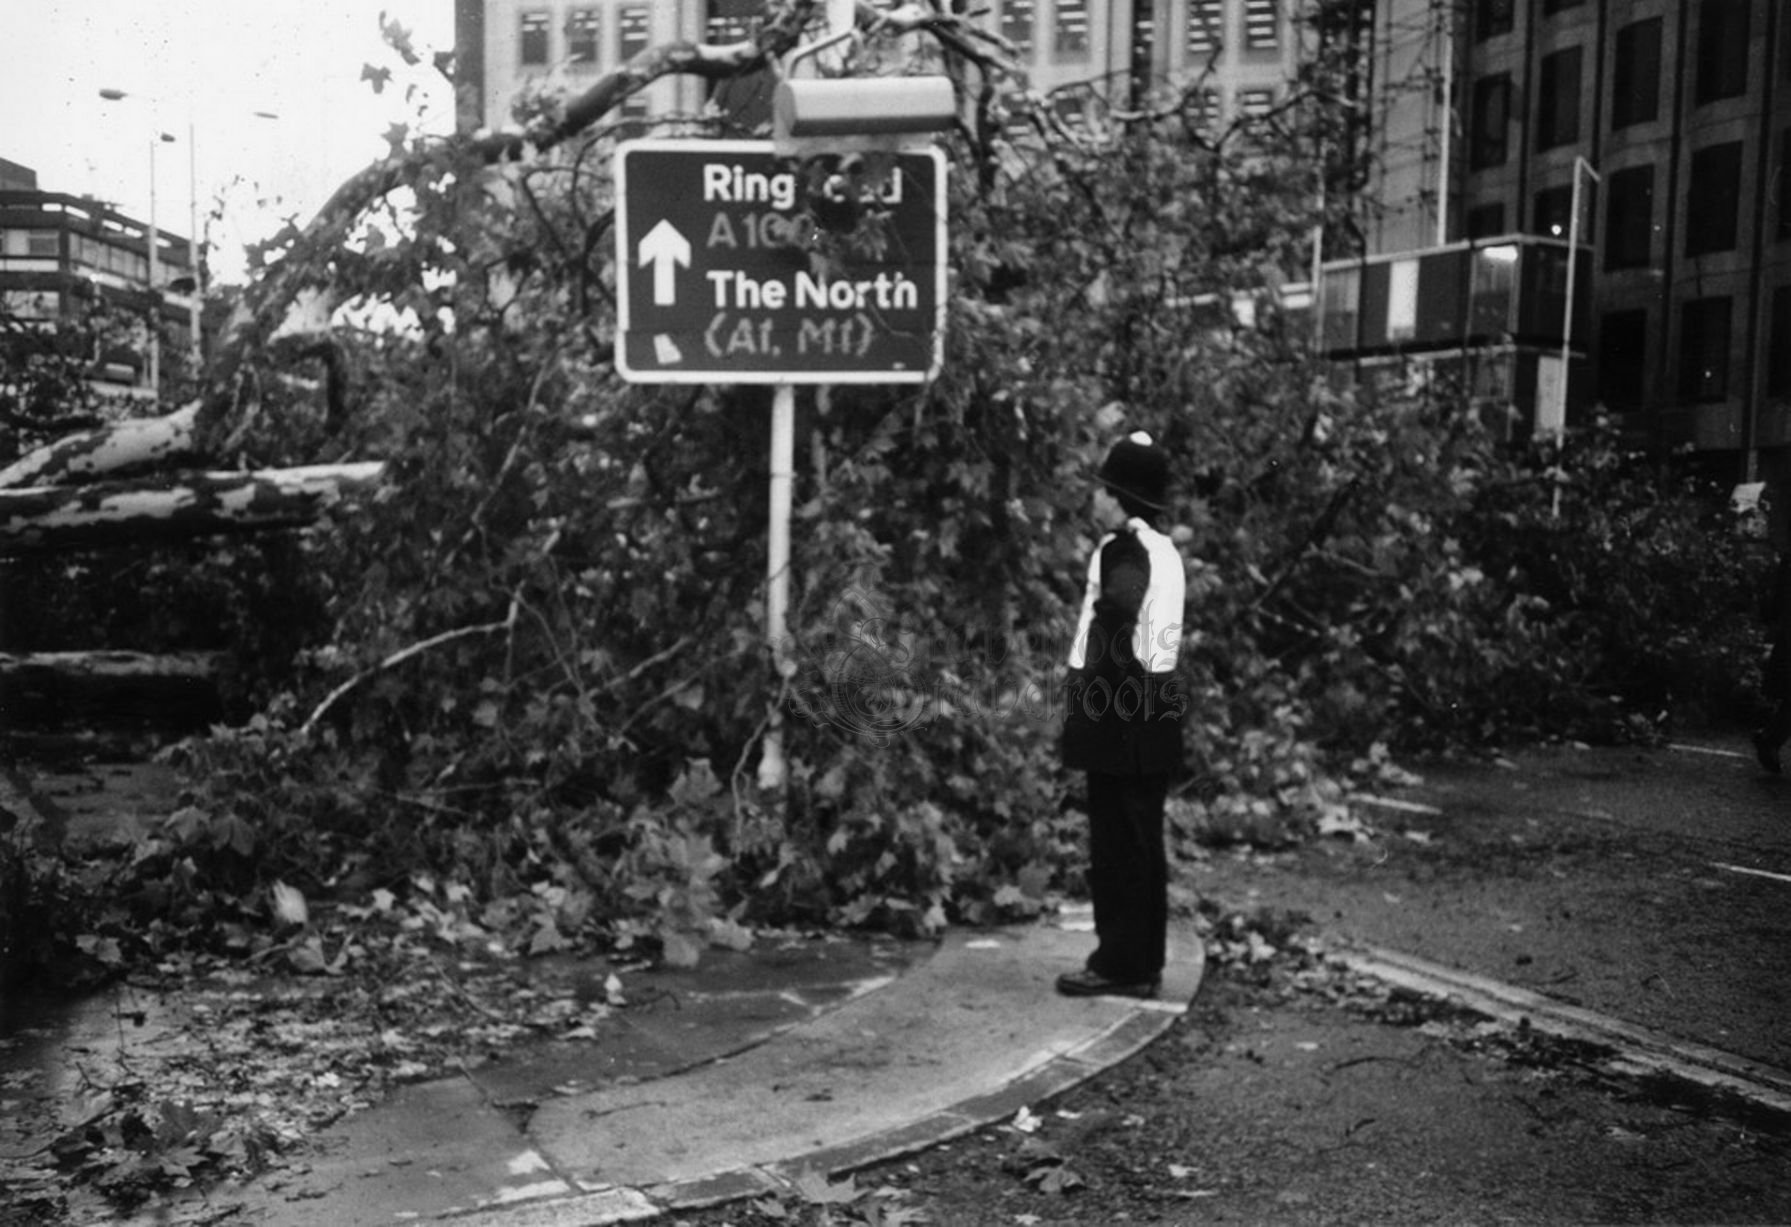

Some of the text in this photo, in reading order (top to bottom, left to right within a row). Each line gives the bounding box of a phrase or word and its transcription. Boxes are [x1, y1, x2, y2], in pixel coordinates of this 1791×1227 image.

[703, 163, 796, 211] Ring
[705, 269, 919, 310] The North
[797, 312, 874, 356] M1)
